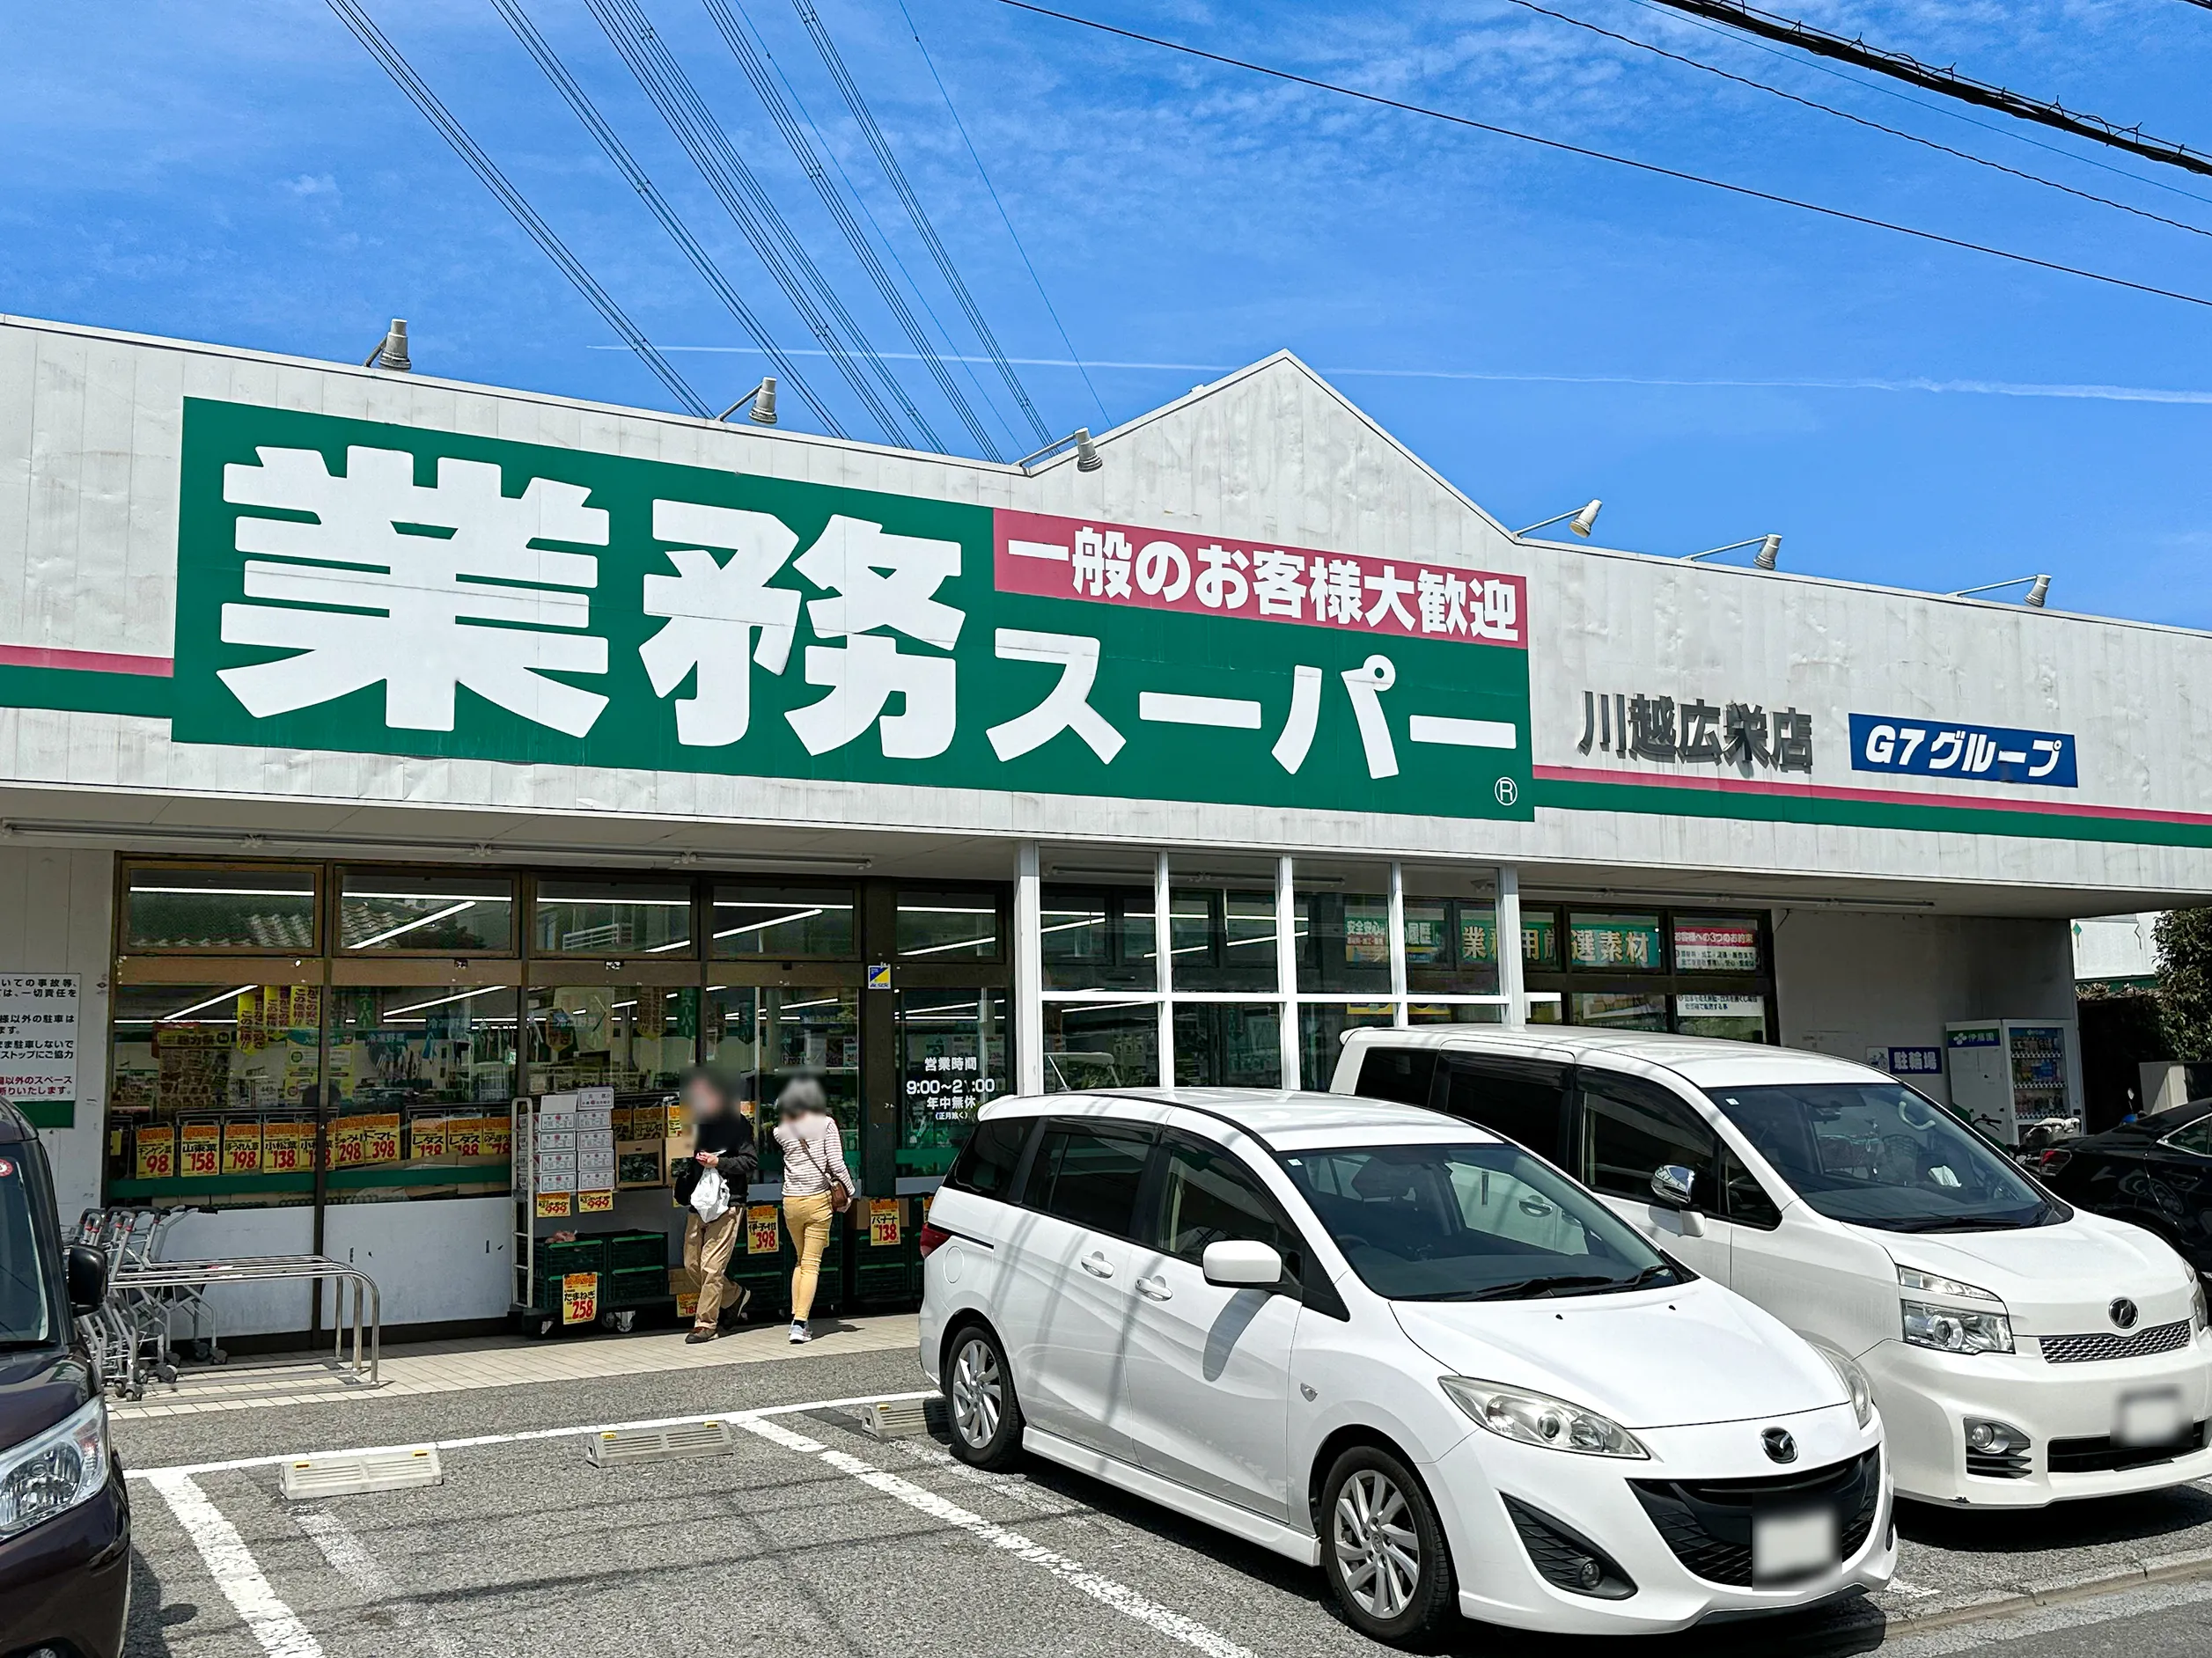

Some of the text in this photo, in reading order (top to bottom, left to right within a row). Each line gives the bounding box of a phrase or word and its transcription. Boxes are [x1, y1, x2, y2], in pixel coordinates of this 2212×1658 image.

[1008, 525, 1520, 642] 一般のお客様大歓迎
[216, 444, 1518, 780] 業務スーパー
[1577, 690, 1812, 774] 川越広栄店
[1865, 724, 2063, 778] G7グループ
[0, 988, 77, 998] は、一切責任を
[0, 1040, 74, 1049] ま駐車しないで
[1, 1050, 74, 1060] ストップにご協力
[924, 1057, 977, 1072] 営業時間
[1893, 1051, 1937, 1070] 駐輪場
[926, 1095, 976, 1110] 年中無休
[371, 1140, 395, 1159] 398
[413, 1135, 445, 1145] レタス
[450, 1135, 481, 1145] レタス
[190, 1151, 216, 1171] 158
[232, 1150, 257, 1169] 198
[273, 1149, 296, 1169] 138
[339, 1142, 362, 1163] 298
[146, 1154, 169, 1173] 98
[546, 1206, 568, 1214] 999
[588, 1199, 610, 1209] 999
[755, 1230, 775, 1249] 398
[878, 1223, 897, 1242] 138
[564, 1291, 596, 1302] たまねぎ
[572, 1299, 594, 1319] 258
